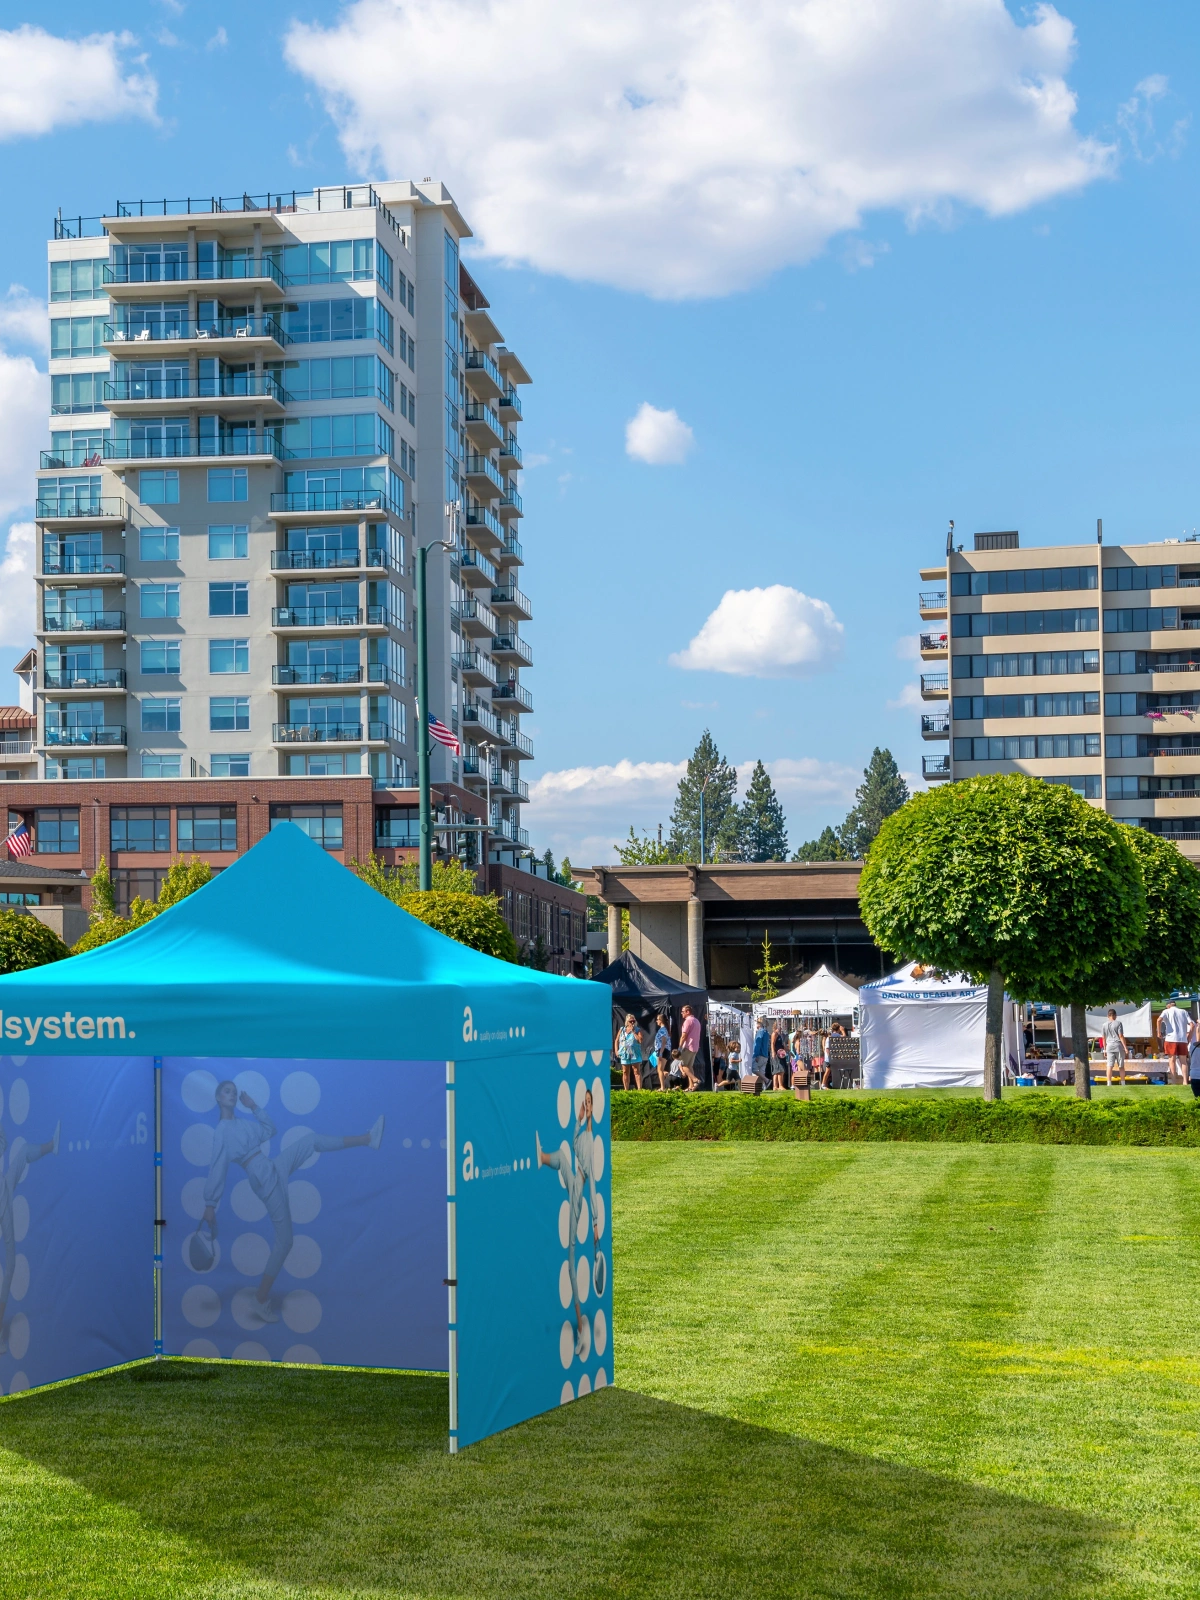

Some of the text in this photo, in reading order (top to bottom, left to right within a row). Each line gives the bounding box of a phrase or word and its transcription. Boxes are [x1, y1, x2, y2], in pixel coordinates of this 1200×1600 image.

[923, 990, 956, 998] BEAGLE
[768, 1007, 793, 1016] Damsel
[463, 1006, 477, 1042] a.
[463, 1141, 479, 1181] a.
